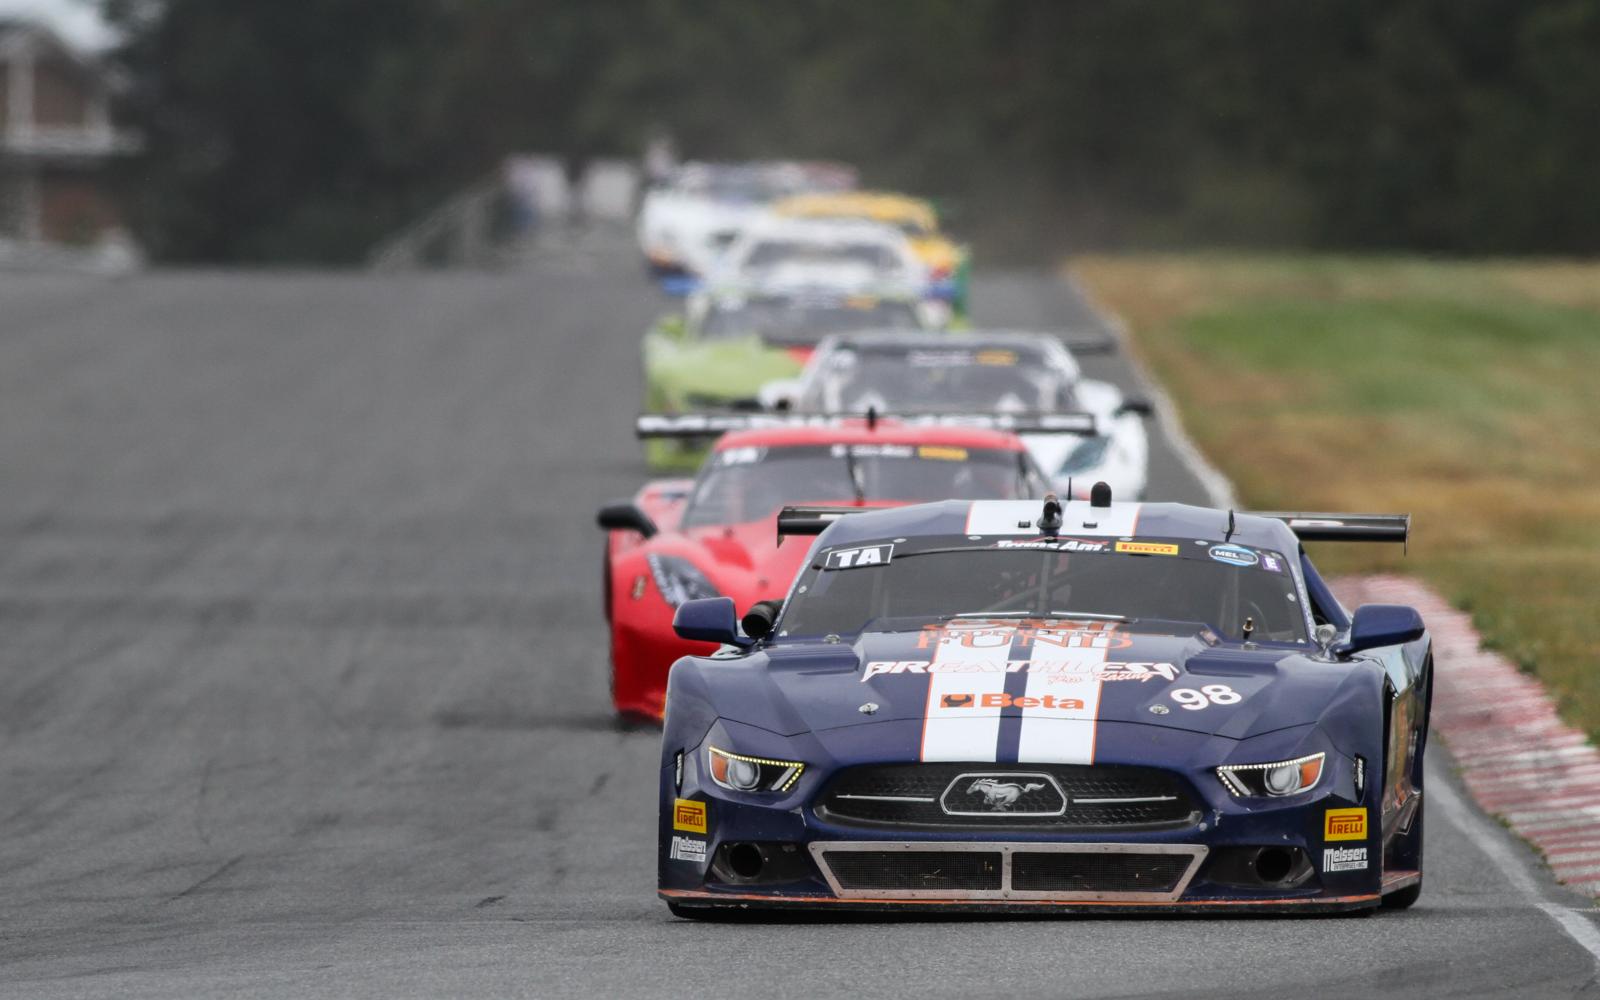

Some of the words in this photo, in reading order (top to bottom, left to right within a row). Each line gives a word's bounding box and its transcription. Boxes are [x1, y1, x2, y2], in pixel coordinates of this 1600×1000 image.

[836, 547, 881, 567] TA
[980, 693, 1085, 709] Beta
[1170, 684, 1243, 711] 98
[676, 805, 704, 827] PIRELLI
[1328, 815, 1364, 834] PIRELLI
[1323, 847, 1368, 872] Meissen
